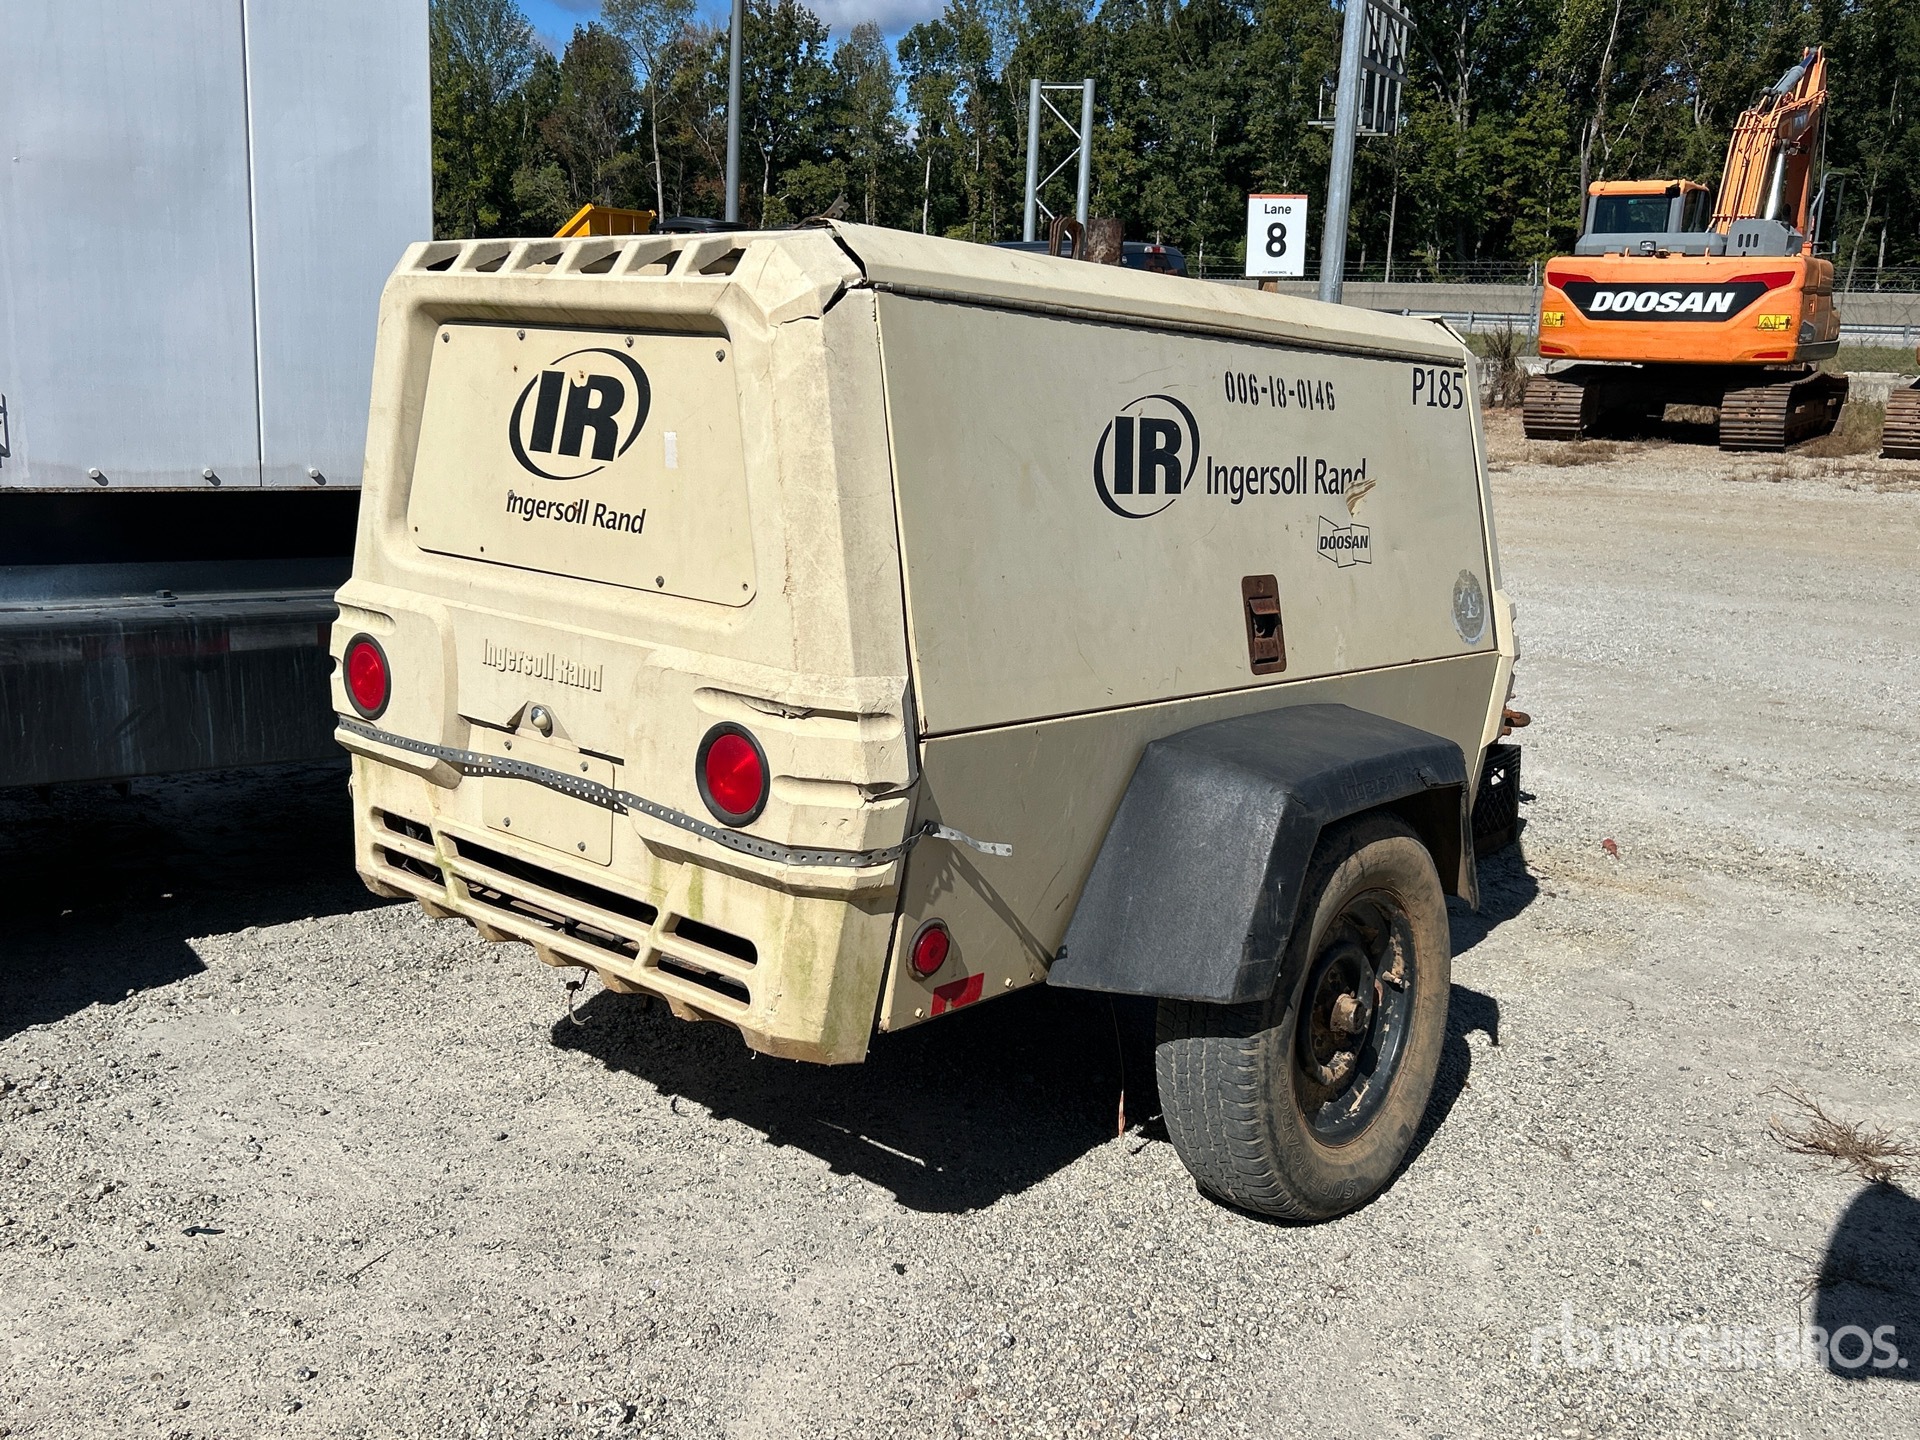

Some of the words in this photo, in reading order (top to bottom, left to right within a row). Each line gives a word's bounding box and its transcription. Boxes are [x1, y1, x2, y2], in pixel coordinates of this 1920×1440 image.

[1264, 203, 1292, 214] Lane
[1265, 222, 1287, 258] 8
[1589, 291, 1736, 313] DOOSAN
[1412, 367, 1463, 409] P185
[529, 370, 625, 462] IR
[1114, 416, 1182, 495] IR
[1206, 456, 1308, 504] Ingersoll
[592, 503, 647, 534] Rand
[1319, 535, 1369, 550] DOOSAN
